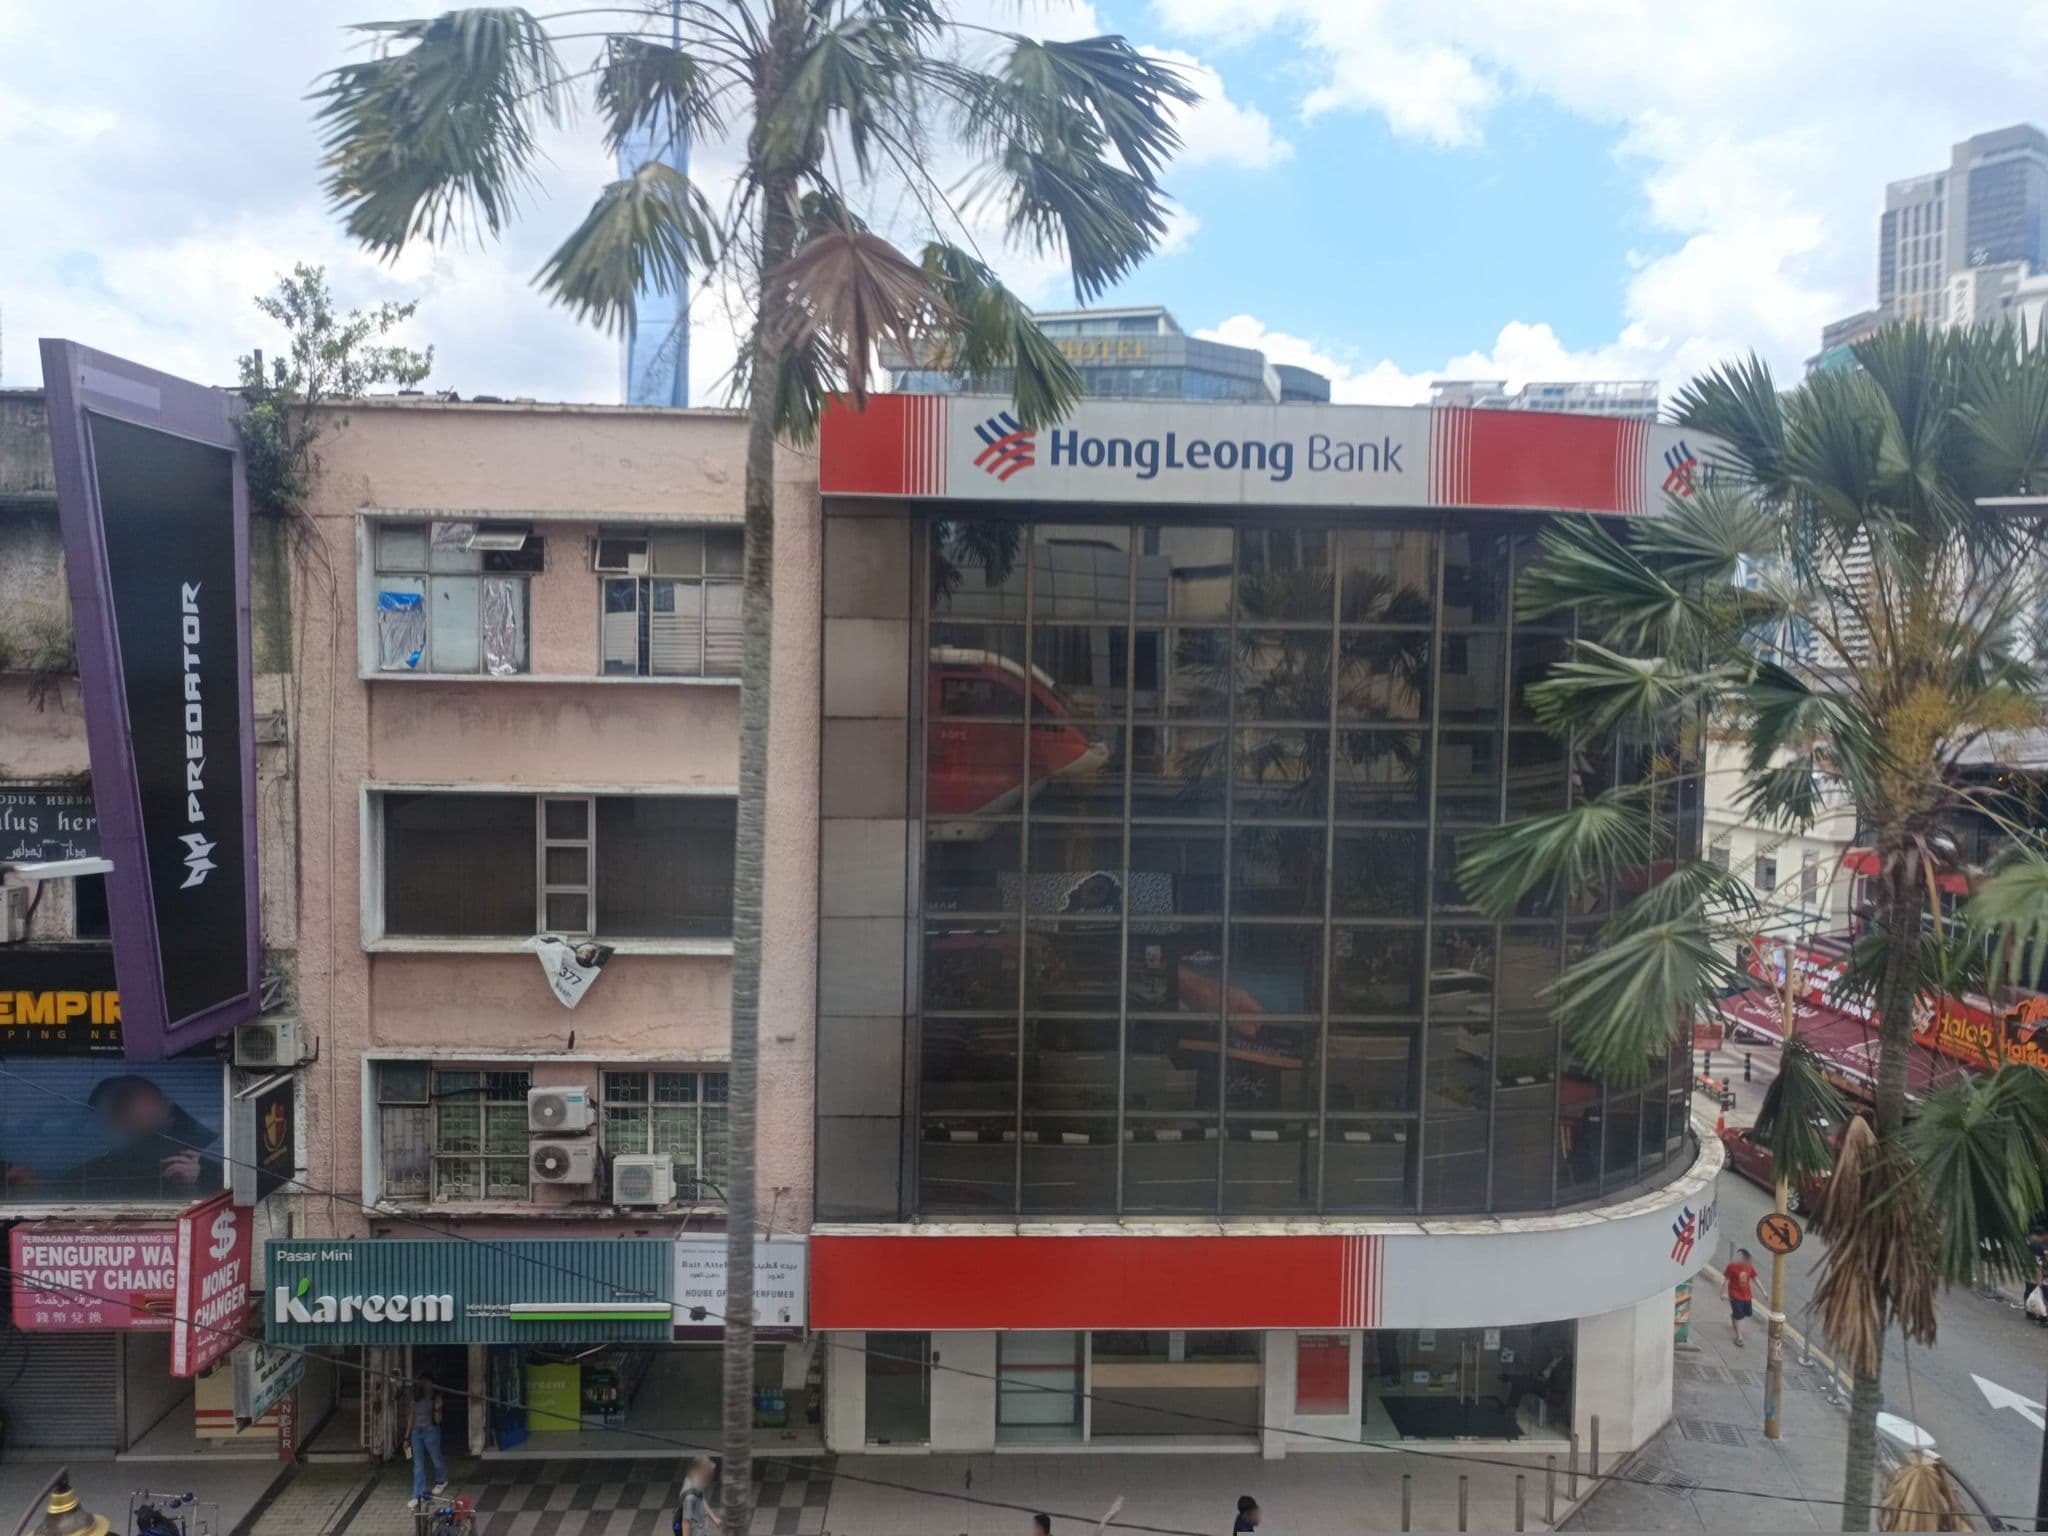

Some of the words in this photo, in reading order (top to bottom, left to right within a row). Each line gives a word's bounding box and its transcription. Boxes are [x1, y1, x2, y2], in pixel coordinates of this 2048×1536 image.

[1308, 434, 1404, 473] Bank
[182, 580, 207, 823] PREDATOR
[0, 806, 39, 834] lus
[559, 967, 582, 985] 377
[75, 1235, 135, 1244] PERKHIDMATAN
[137, 1235, 161, 1244] WANG
[22, 1246, 136, 1266] PENGURUP
[142, 1246, 175, 1266] WA
[276, 1250, 318, 1263] Pasar
[321, 1249, 353, 1263] Mini
[23, 1270, 97, 1290] MONEY
[103, 1270, 176, 1290] CHANG
[202, 1258, 241, 1302] MONEY
[275, 1284, 454, 1323] Kareem
[685, 1289, 713, 1298] HOUSE
[194, 1283, 246, 1334] CHANGER
